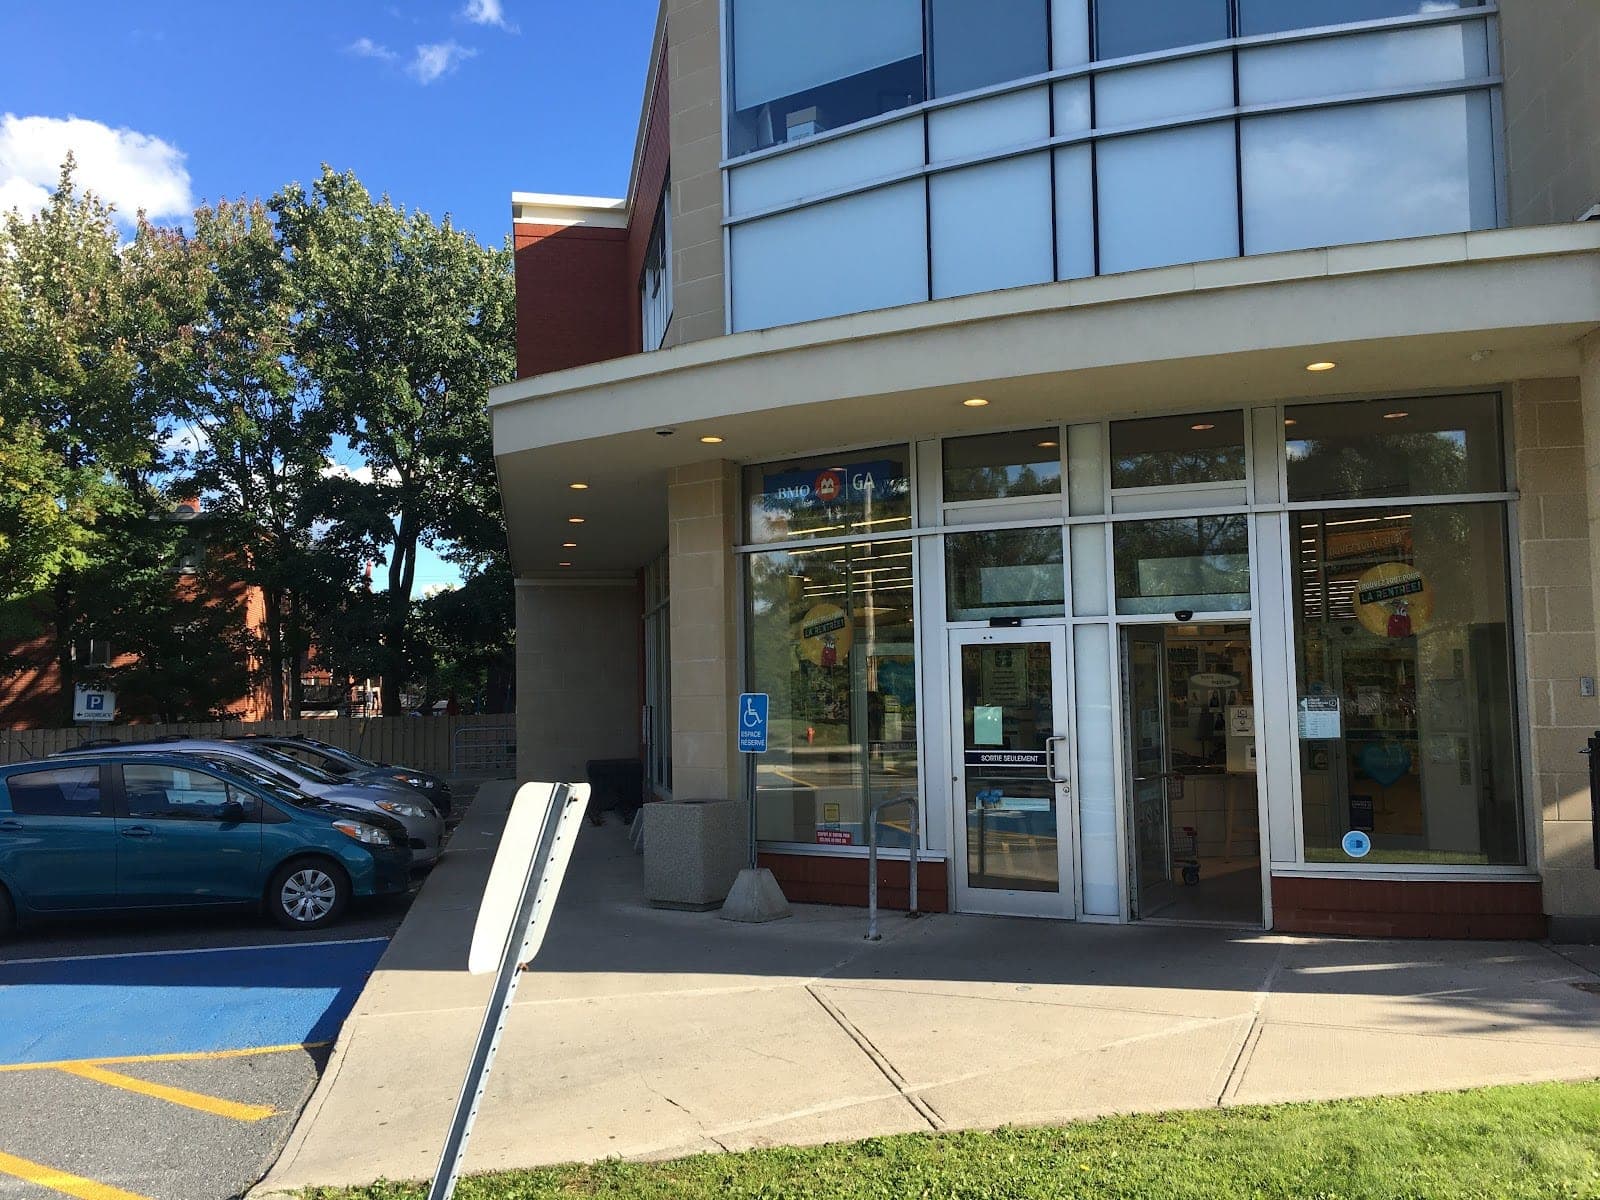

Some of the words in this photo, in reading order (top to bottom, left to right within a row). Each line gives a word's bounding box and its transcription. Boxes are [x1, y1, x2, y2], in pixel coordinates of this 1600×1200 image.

[777, 484, 811, 500] BMO
[981, 754, 1002, 762] SORTIE
[1003, 755, 1039, 763] SEULEMENT
